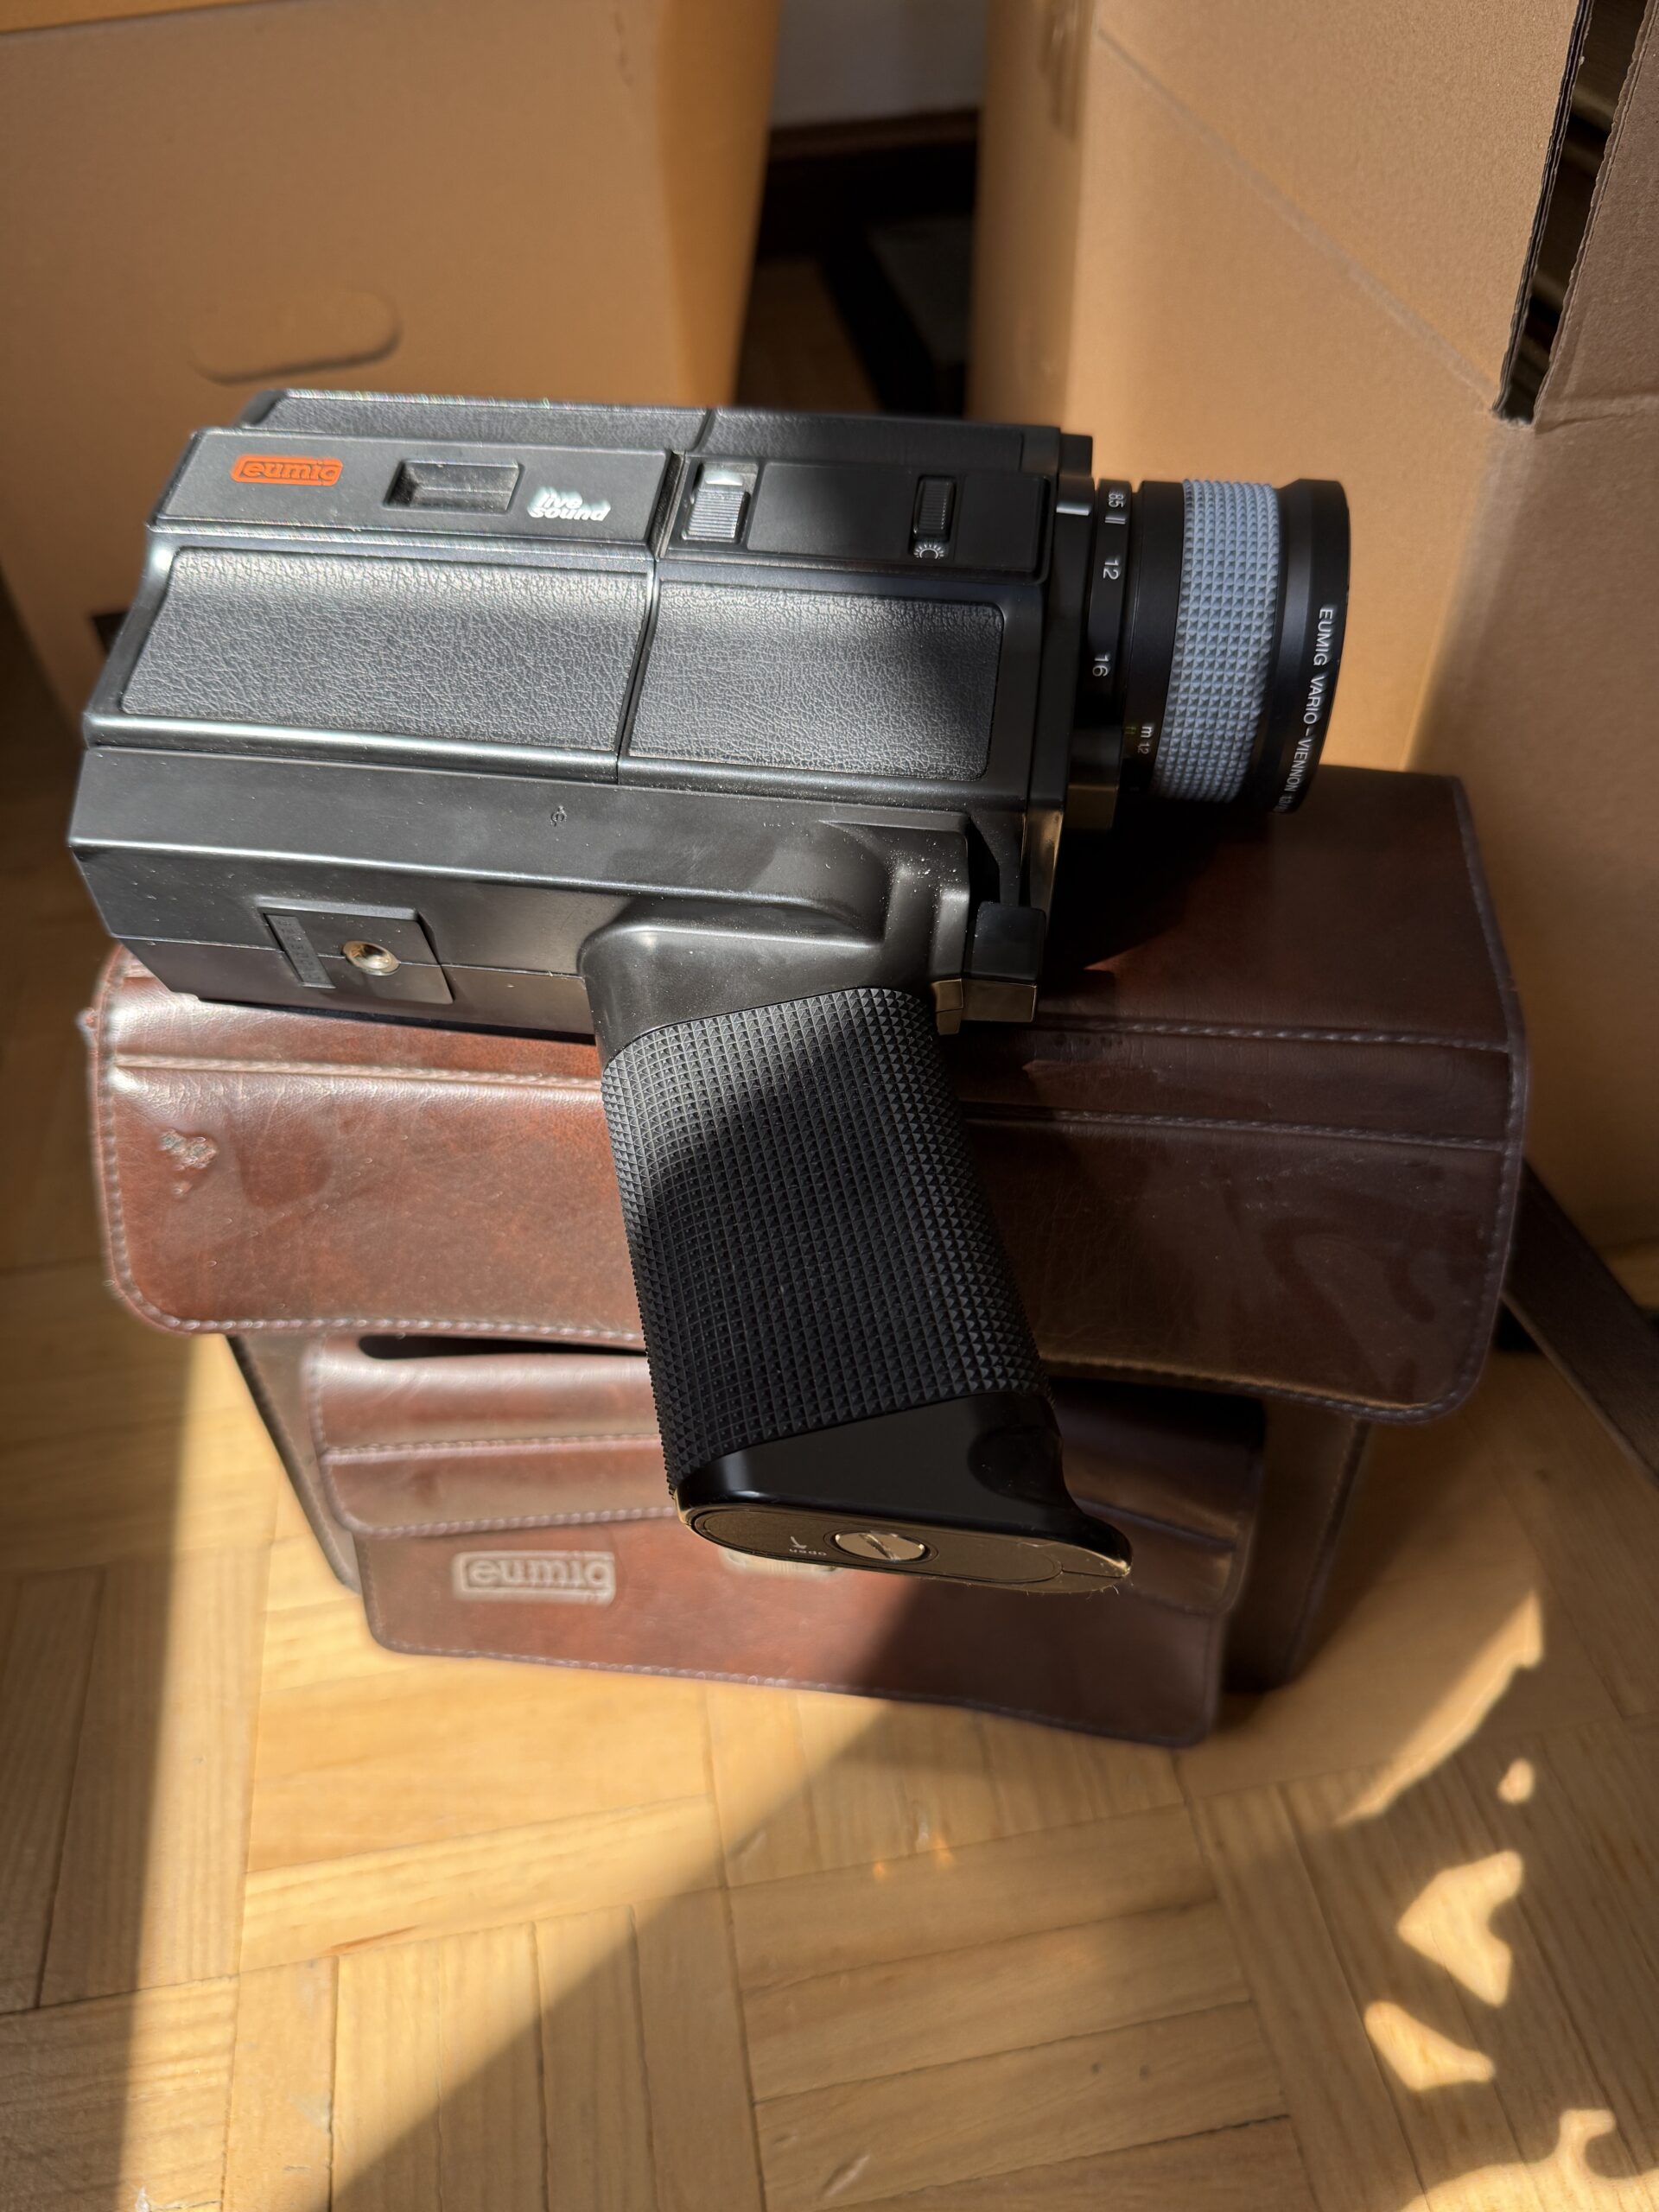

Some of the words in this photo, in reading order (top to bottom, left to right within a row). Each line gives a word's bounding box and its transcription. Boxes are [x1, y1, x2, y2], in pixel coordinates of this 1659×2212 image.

[238, 458, 343, 485] eumig
[531, 486, 583, 510] live
[527, 500, 612, 522] sound
[1103, 558, 1120, 580] 12
[1313, 607, 1333, 666] EUMIG
[1092, 654, 1109, 677] 16
[1140, 724, 1153, 738] m
[789, 1548, 828, 1556] open
[467, 1556, 615, 1599] eumig
